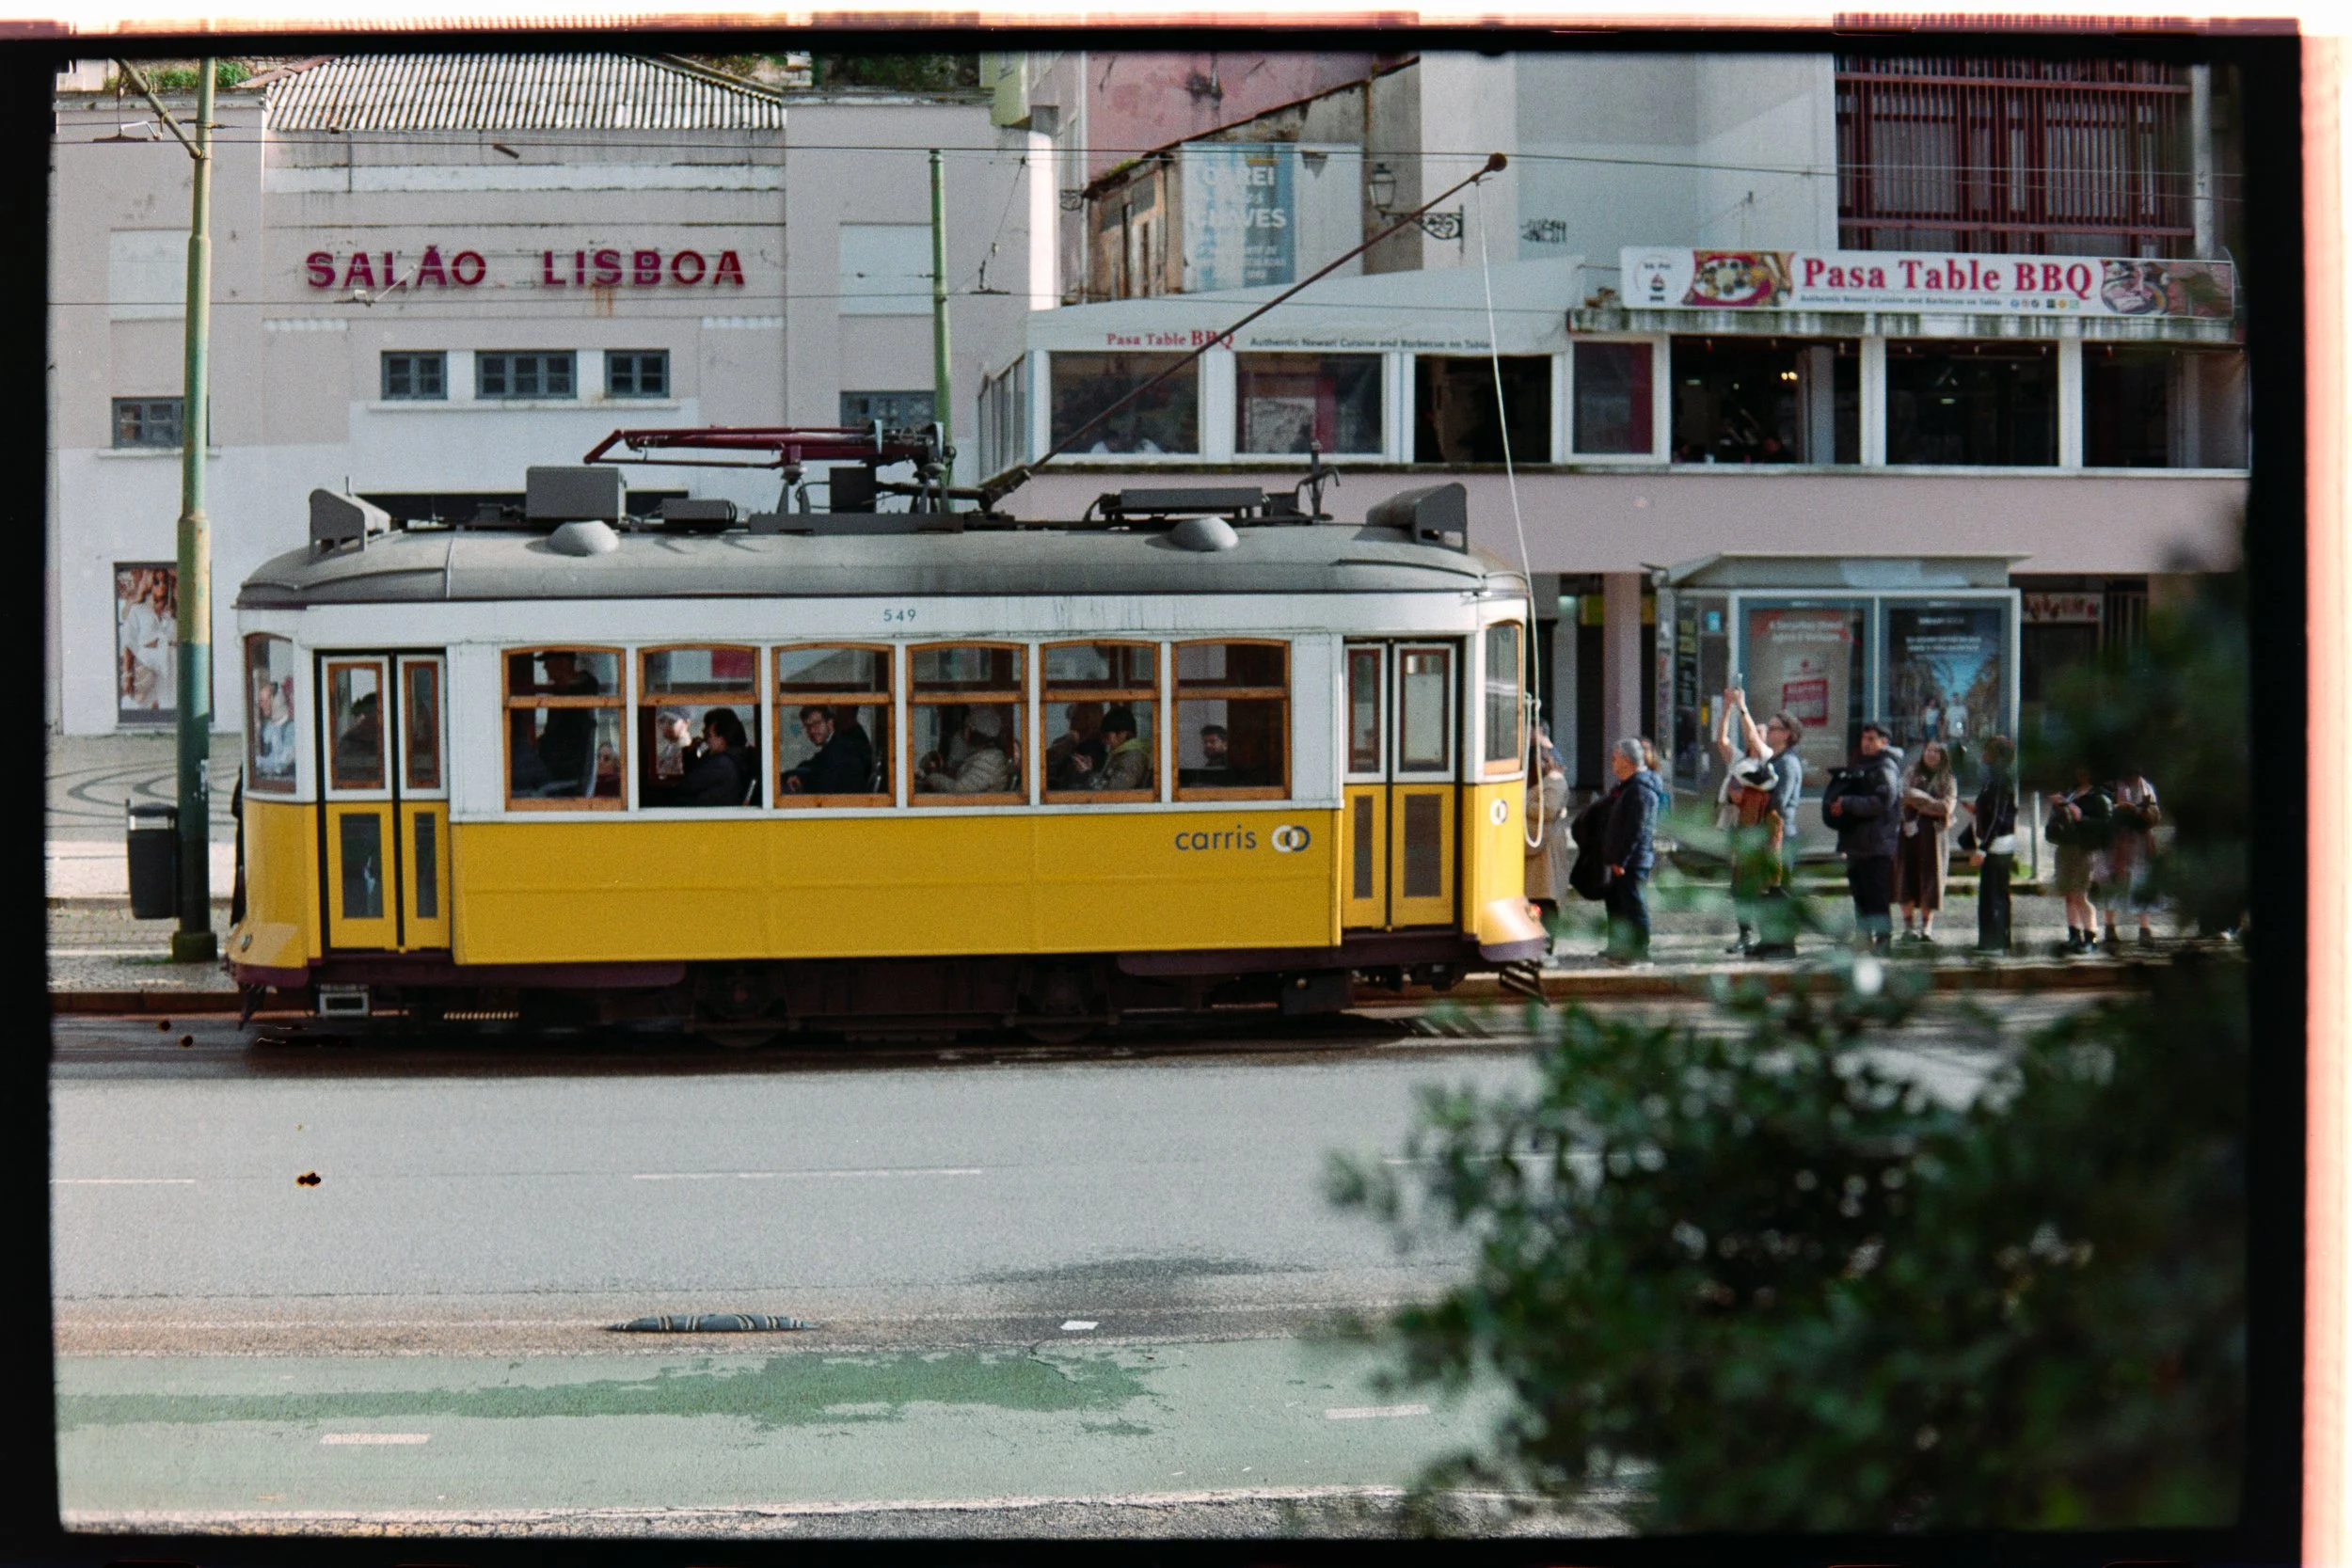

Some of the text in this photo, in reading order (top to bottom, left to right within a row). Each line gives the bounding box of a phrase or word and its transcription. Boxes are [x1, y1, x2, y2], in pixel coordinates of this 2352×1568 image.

[306, 245, 746, 288] SALÃO LISBOA
[1803, 257, 2092, 300] Pasa Table BBQ
[1106, 329, 1234, 350] Pasa Table BBQ
[1250, 337, 1298, 347] Authentic
[883, 608, 916, 622] 549
[1174, 823, 1258, 851] carris
